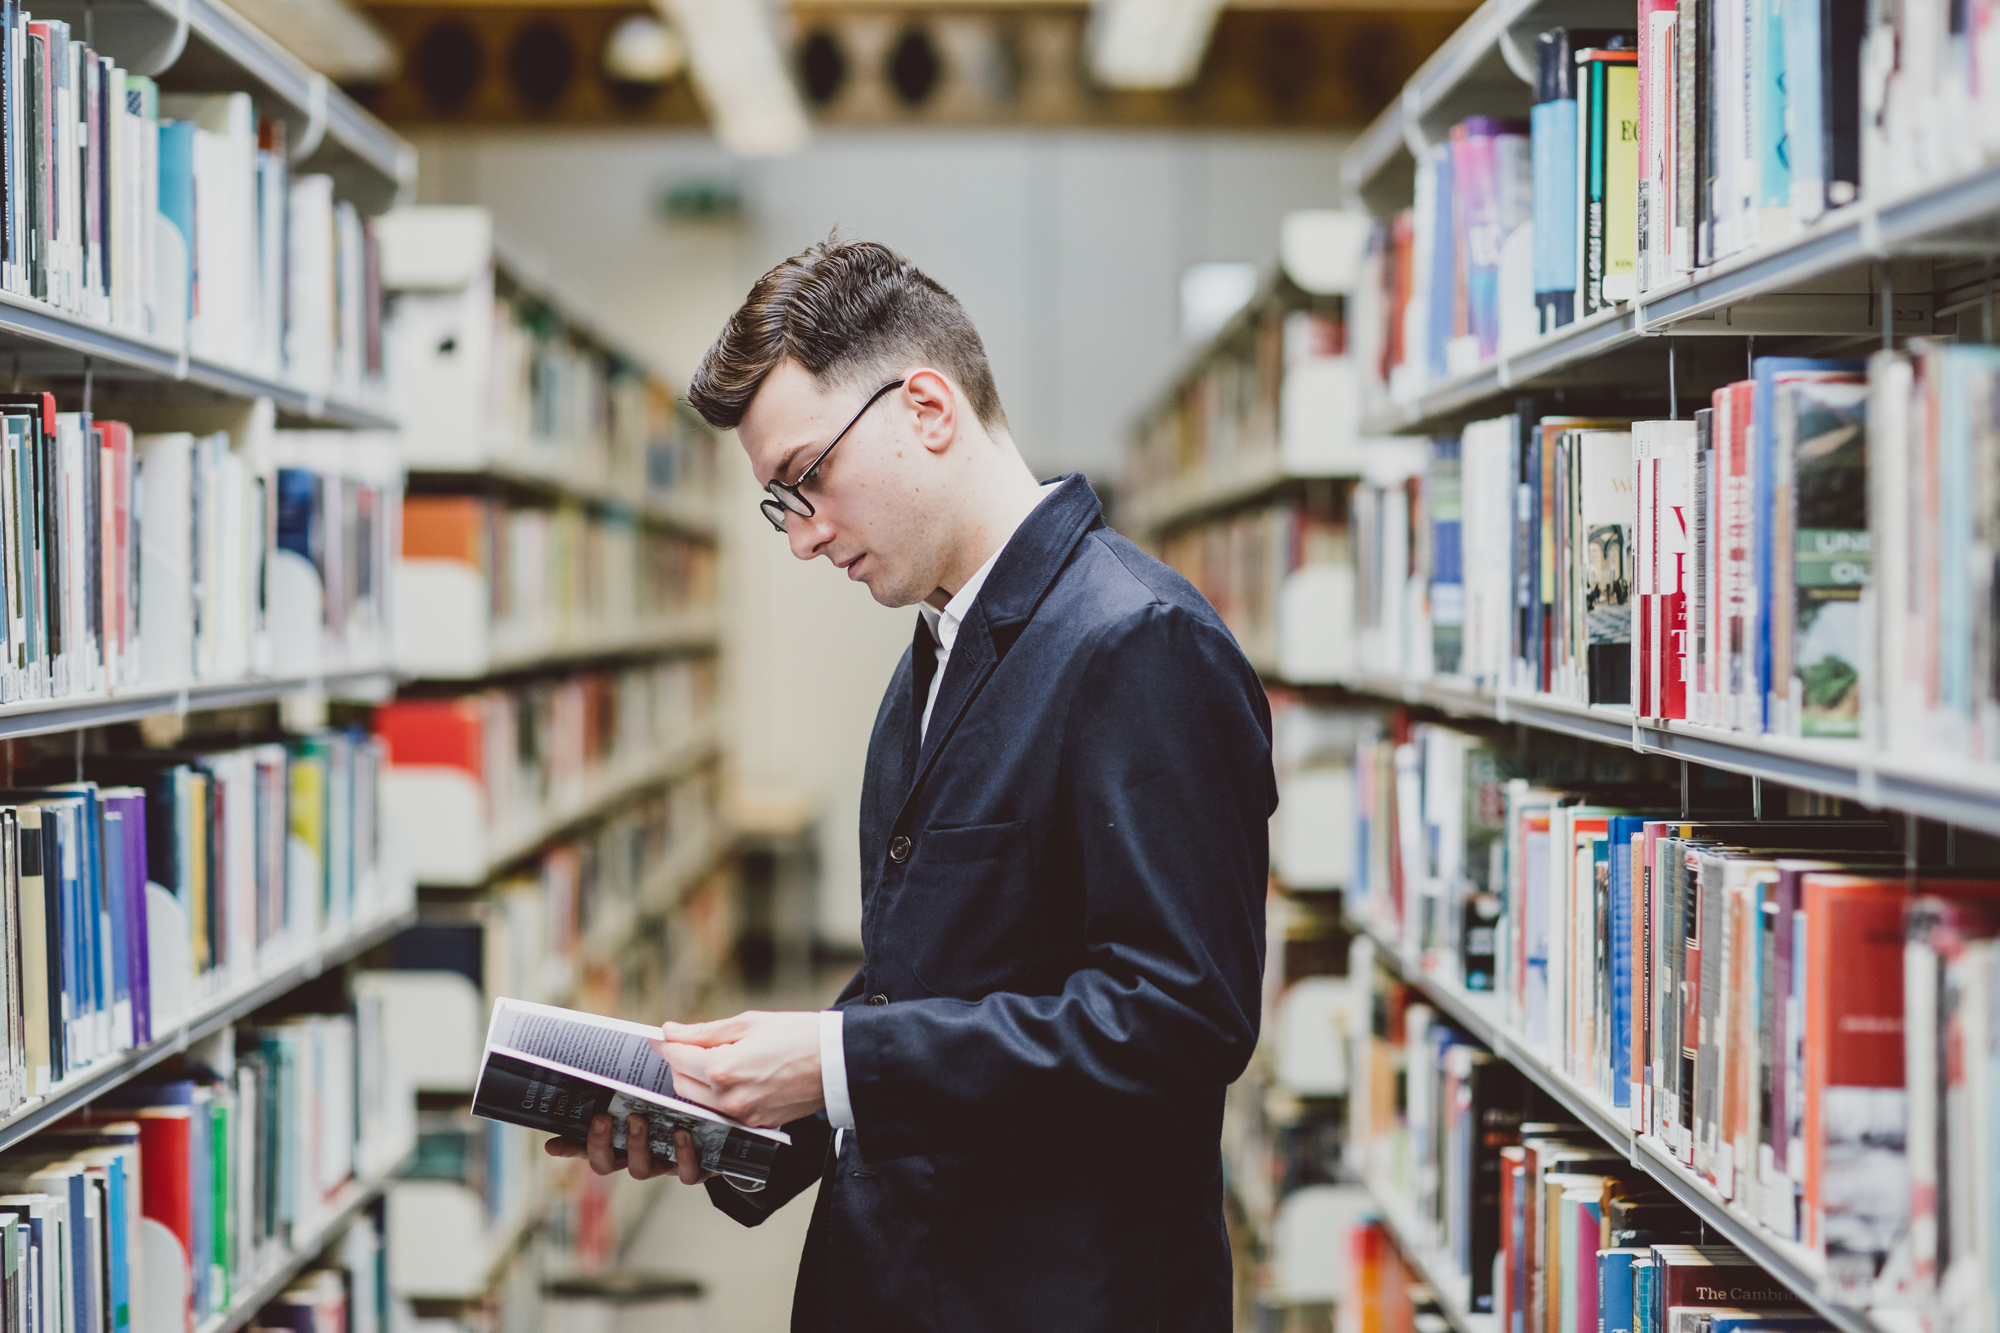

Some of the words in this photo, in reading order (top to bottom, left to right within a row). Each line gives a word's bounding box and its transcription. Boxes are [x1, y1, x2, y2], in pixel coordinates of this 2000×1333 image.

[1589, 201, 1602, 238] WITH
[1589, 237, 1602, 280] STUDY
[1588, 280, 1602, 309] TIPS
[1696, 1286, 1727, 1300] The
